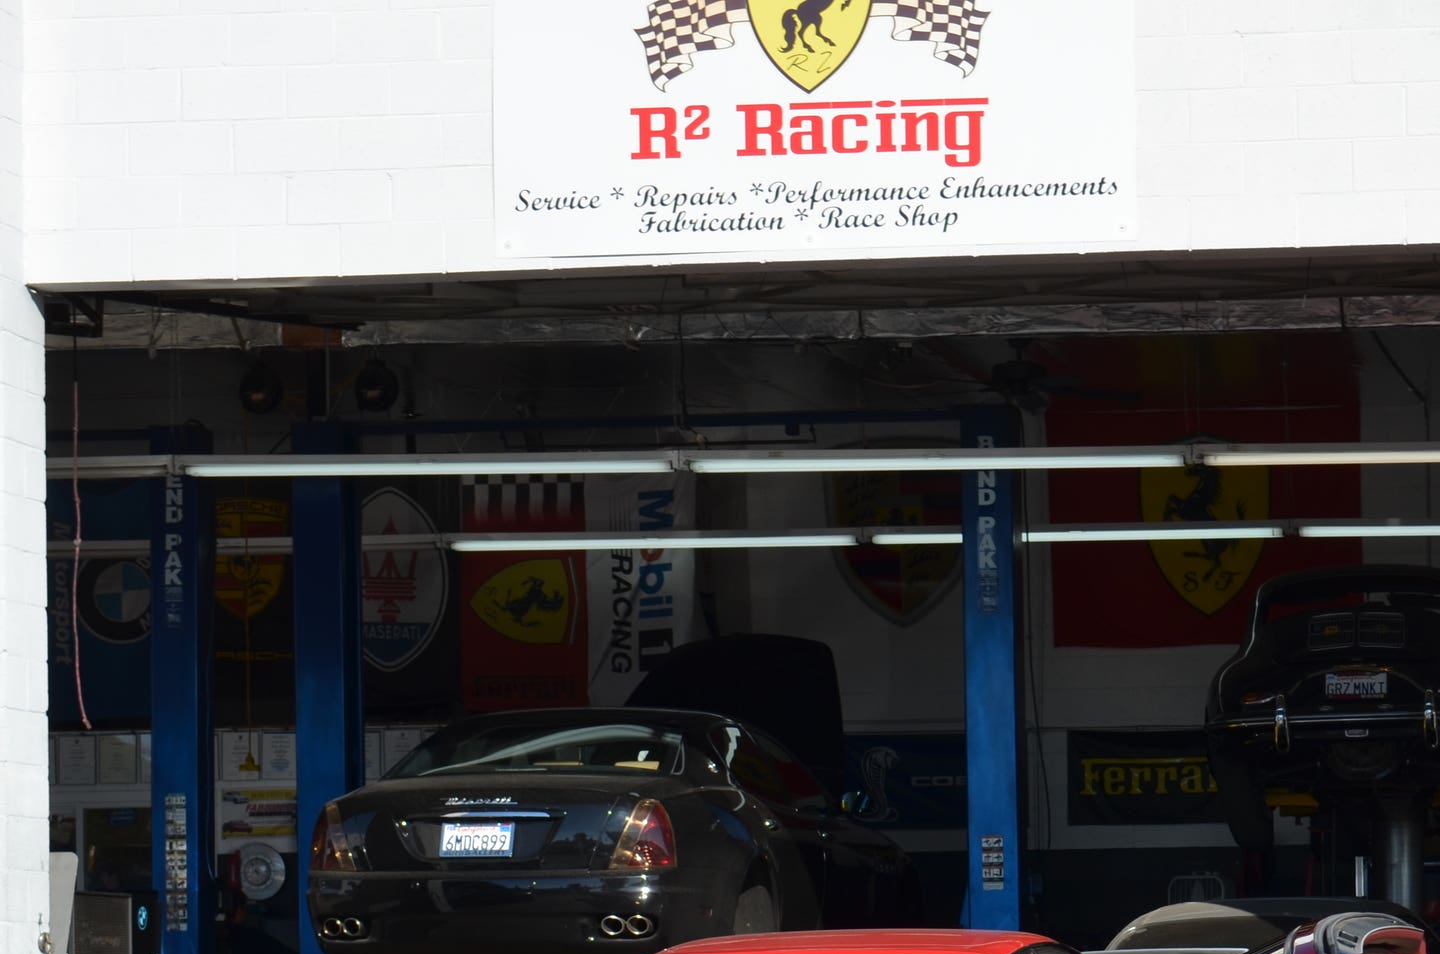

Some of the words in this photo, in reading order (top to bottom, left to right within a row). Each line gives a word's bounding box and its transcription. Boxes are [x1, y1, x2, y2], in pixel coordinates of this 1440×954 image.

[735, 97, 990, 168] Racing
[515, 189, 601, 212] Service
[633, 184, 738, 213] Repairs
[939, 176, 1119, 200] Enhancements
[638, 210, 785, 234] Fabrication
[817, 205, 887, 230] Race
[895, 203, 960, 234] Shop
[976, 435, 997, 506] BND
[164, 533, 184, 586] PAK
[977, 516, 997, 569] PAK
[51, 521, 74, 665] Mtorsport
[610, 552, 633, 674] RACING
[445, 834, 507, 851] 6MDC899
